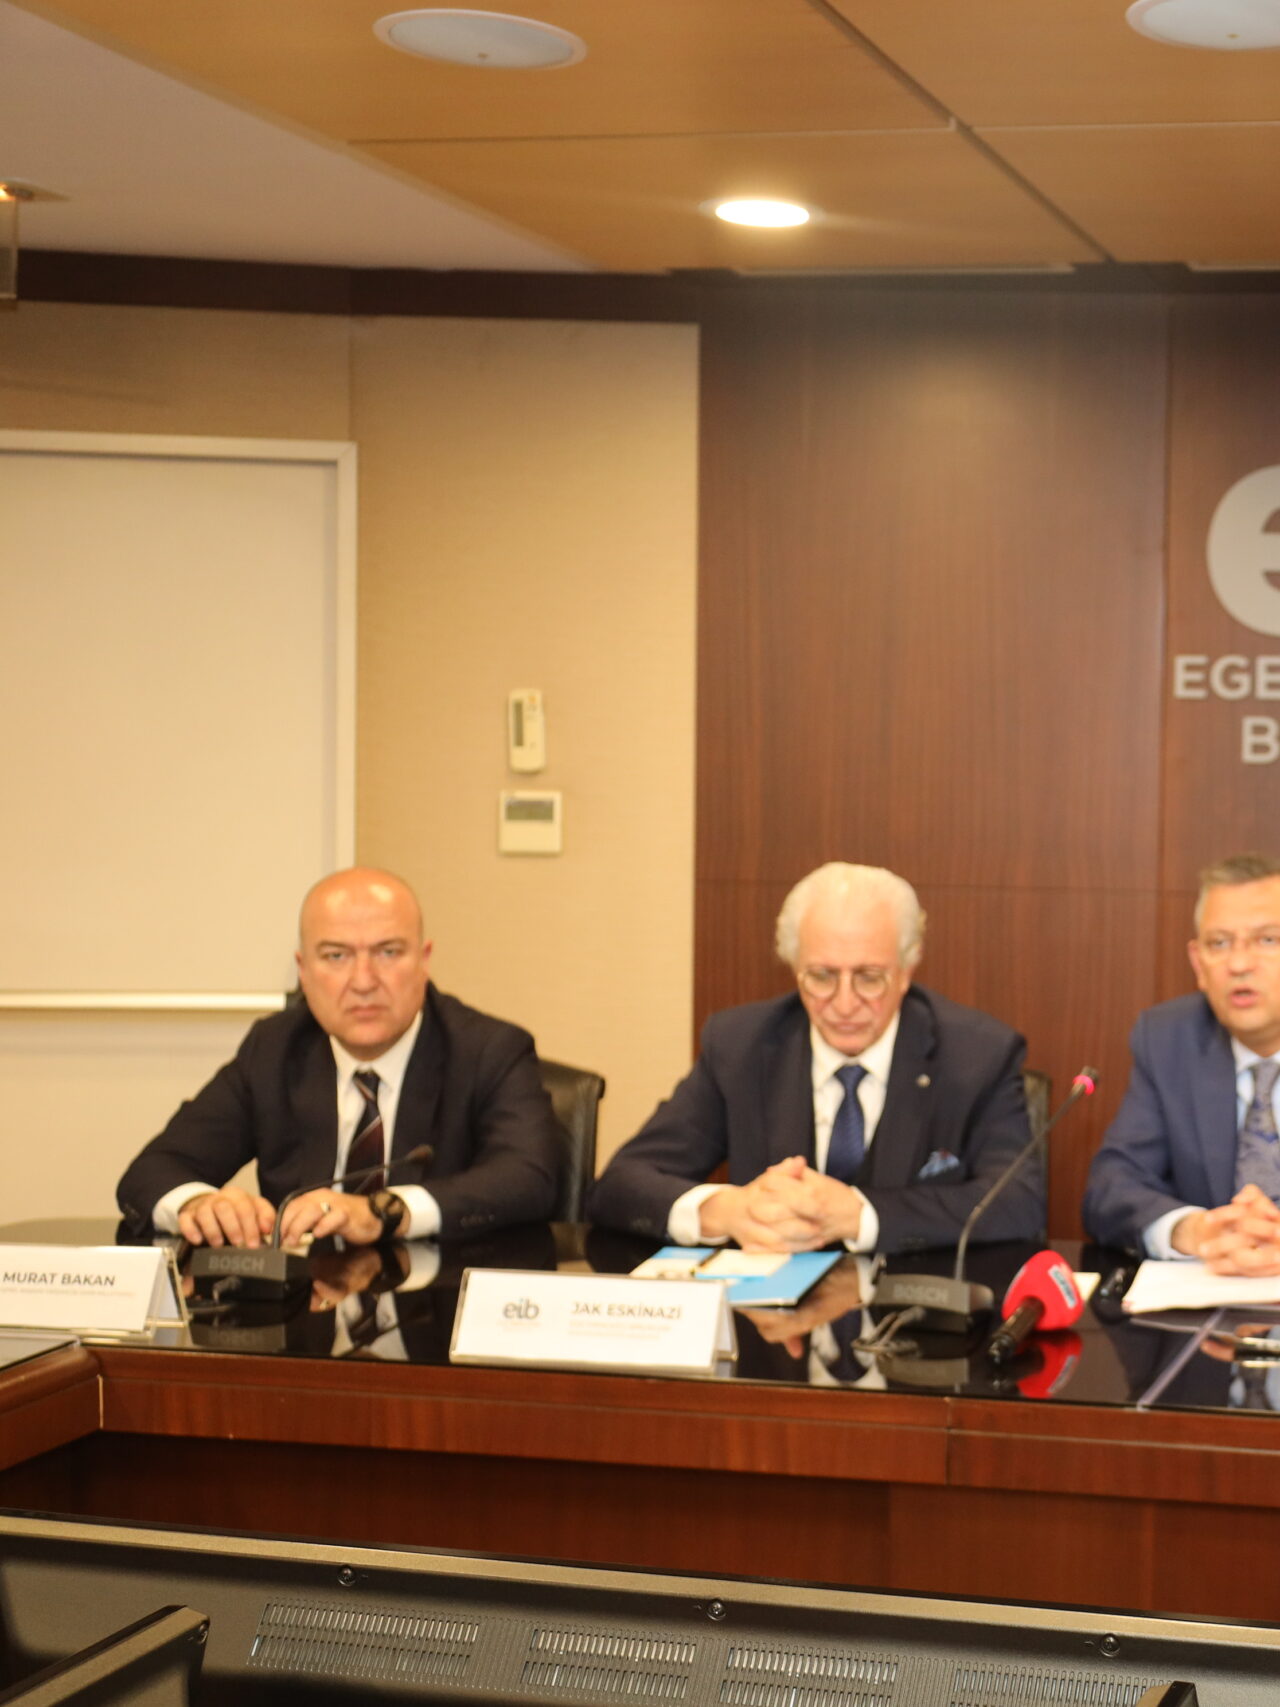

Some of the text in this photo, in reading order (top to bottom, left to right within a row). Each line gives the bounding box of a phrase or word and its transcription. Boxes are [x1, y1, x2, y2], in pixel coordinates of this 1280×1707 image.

[207, 1254, 266, 1272] BOSCH
[2, 1271, 116, 1288] MURAT BAKAN
[502, 1298, 540, 1320] eib
[571, 1301, 600, 1317] JAK
